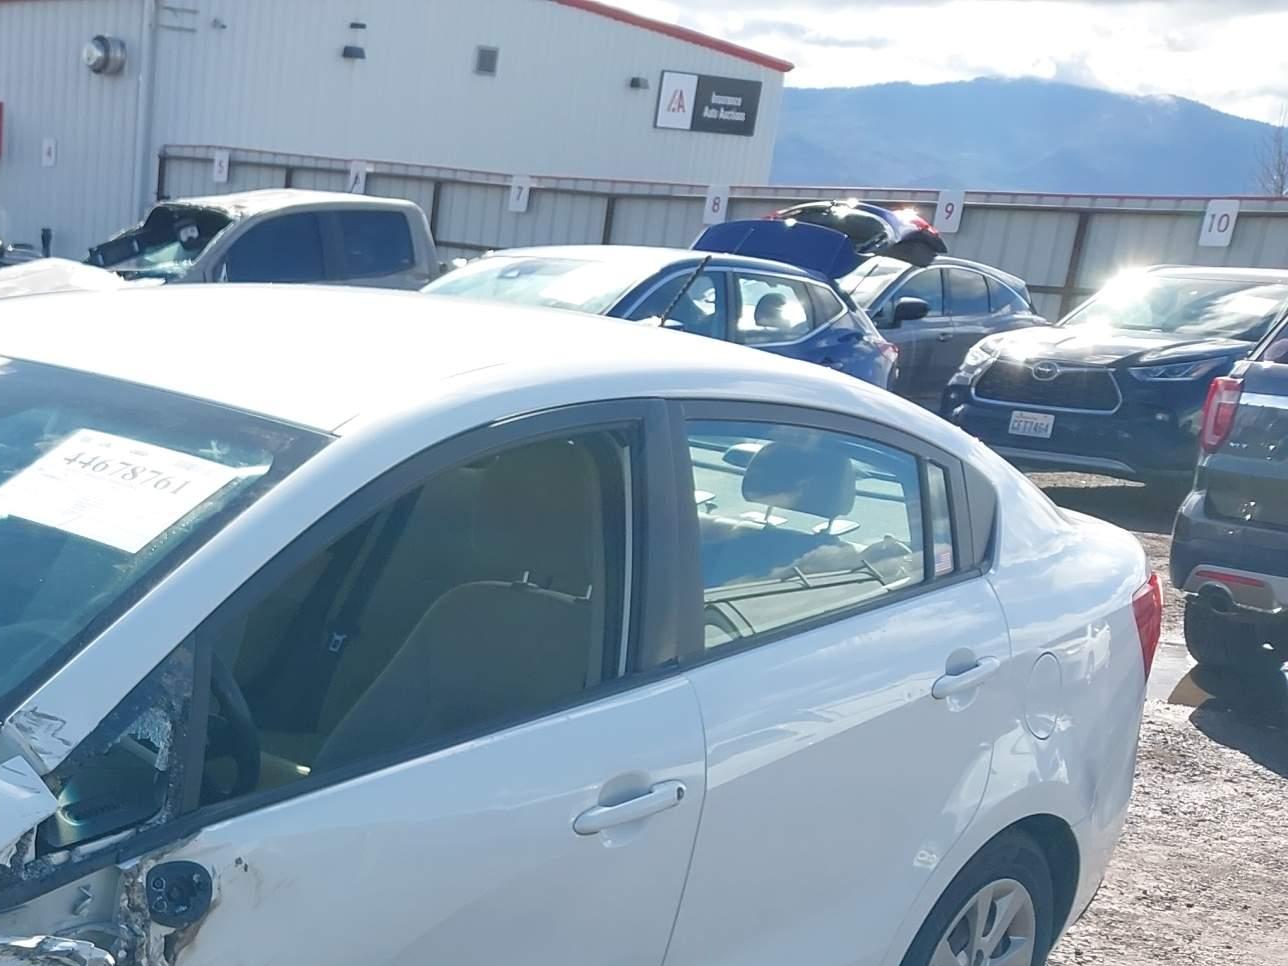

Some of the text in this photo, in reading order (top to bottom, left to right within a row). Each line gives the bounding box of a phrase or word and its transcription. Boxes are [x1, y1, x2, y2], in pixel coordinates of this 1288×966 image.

[703, 106, 746, 121] Auto Auctions
[516, 185, 524, 201] 7
[711, 196, 721, 213] 8
[944, 202, 955, 220] 9
[1207, 213, 1231, 233] 10
[63, 451, 193, 495] 44678761
